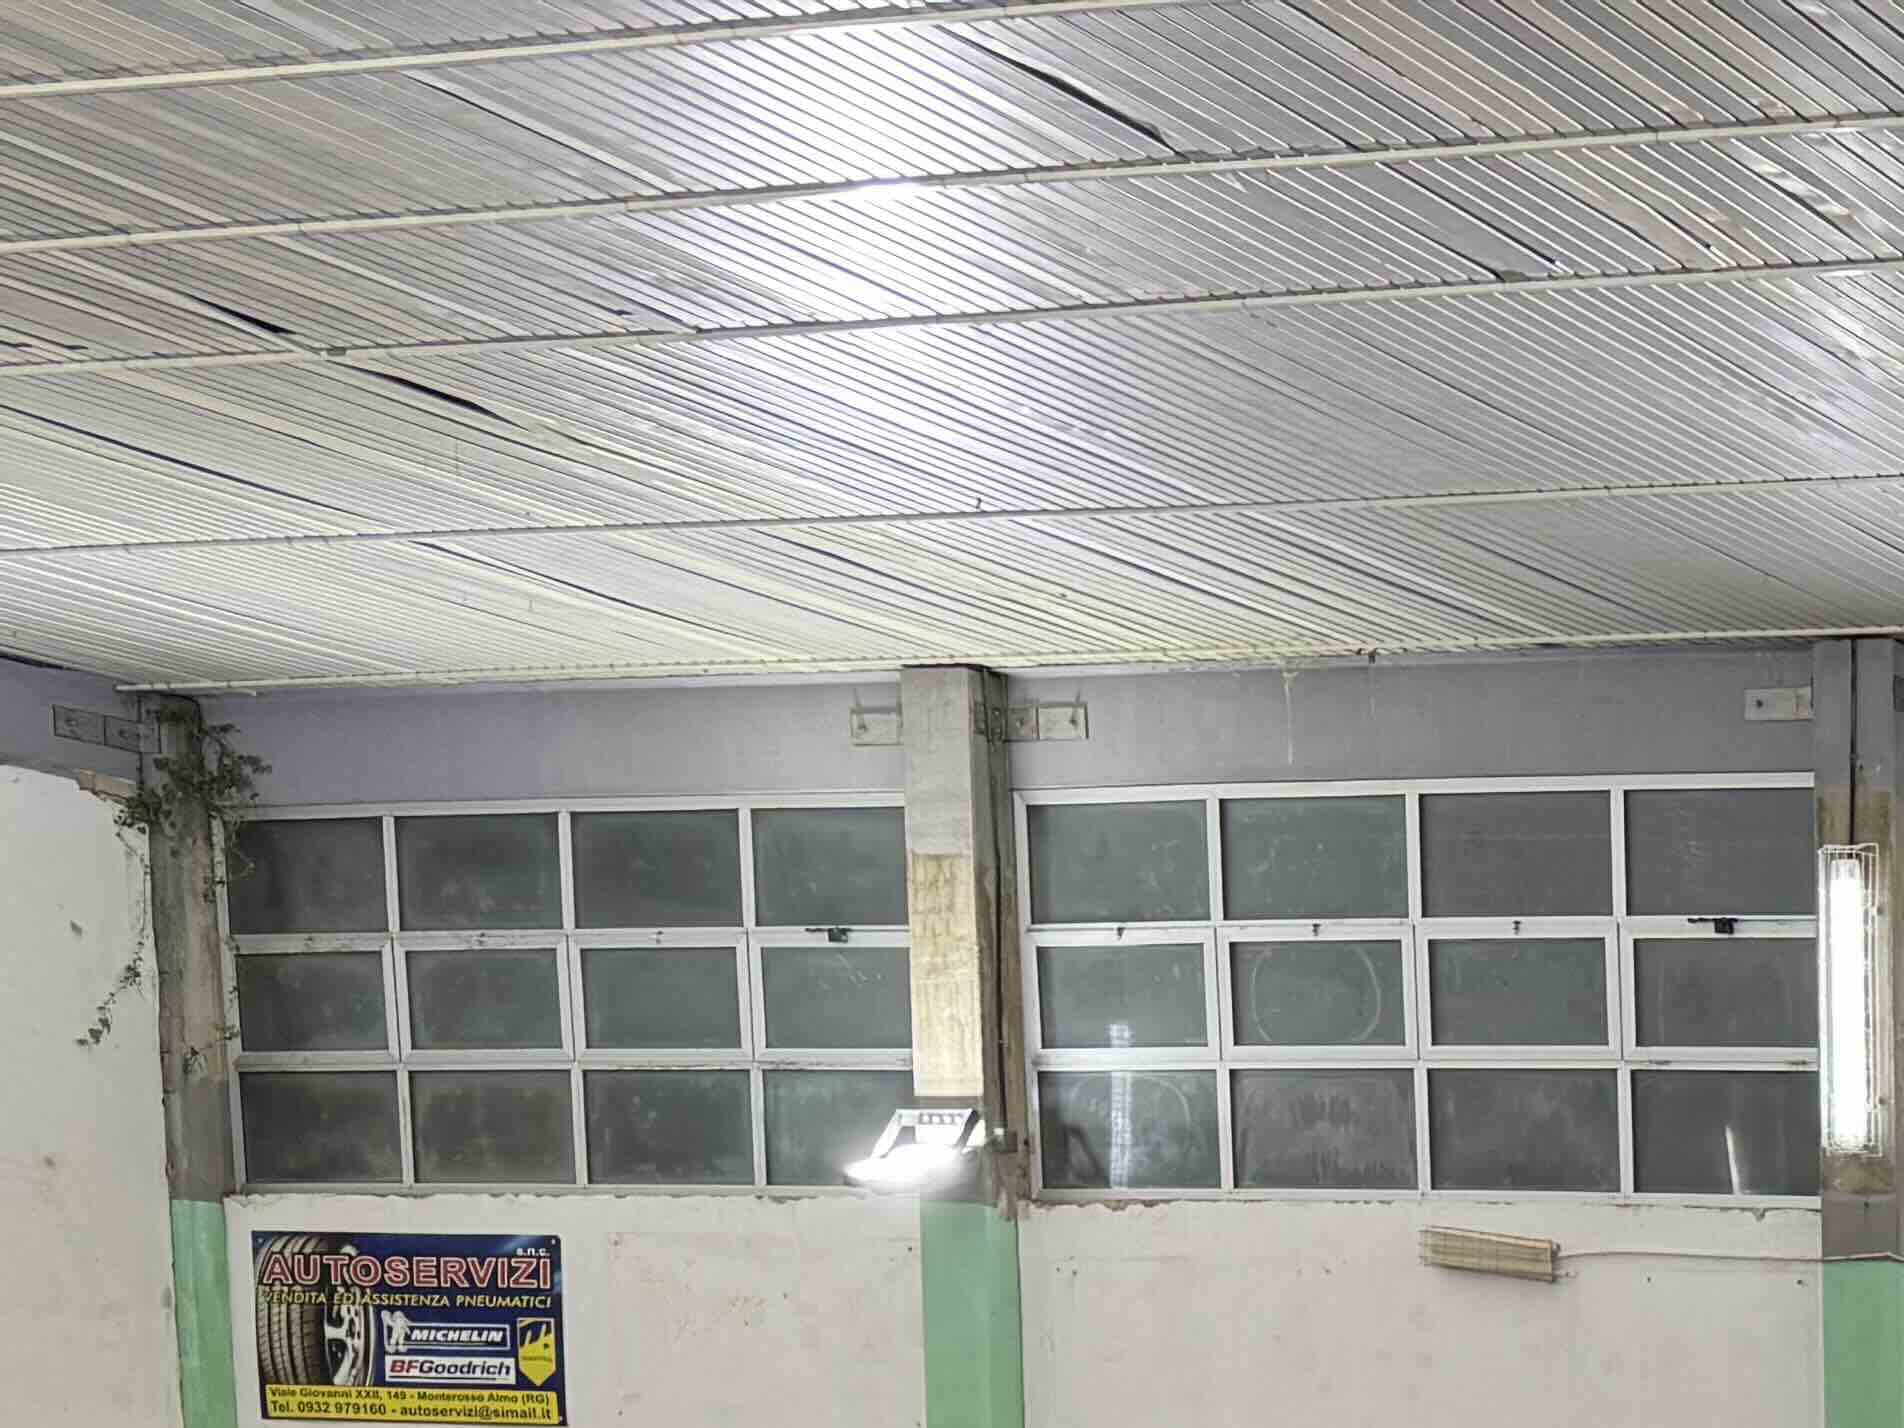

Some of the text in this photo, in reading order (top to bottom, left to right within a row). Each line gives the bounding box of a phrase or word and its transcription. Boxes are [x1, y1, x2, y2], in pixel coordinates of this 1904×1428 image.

[262, 1253, 550, 1289] AUTOSERVIZI
[265, 1290, 326, 1304] VENDITA
[362, 1294, 450, 1307] ASSISTENZA
[456, 1296, 550, 1308] PNEUMATICI
[411, 1330, 502, 1342] MICHELIN
[389, 1360, 510, 1376] BFGoodrich
[270, 1387, 296, 1398] Viale
[301, 1388, 350, 1400] Giovanni
[417, 1391, 484, 1402] Monterosso
[522, 1393, 549, 1404] (RG)
[270, 1401, 294, 1413] Tel.
[298, 1402, 331, 1414] 0932
[336, 1402, 386, 1415] 979160
